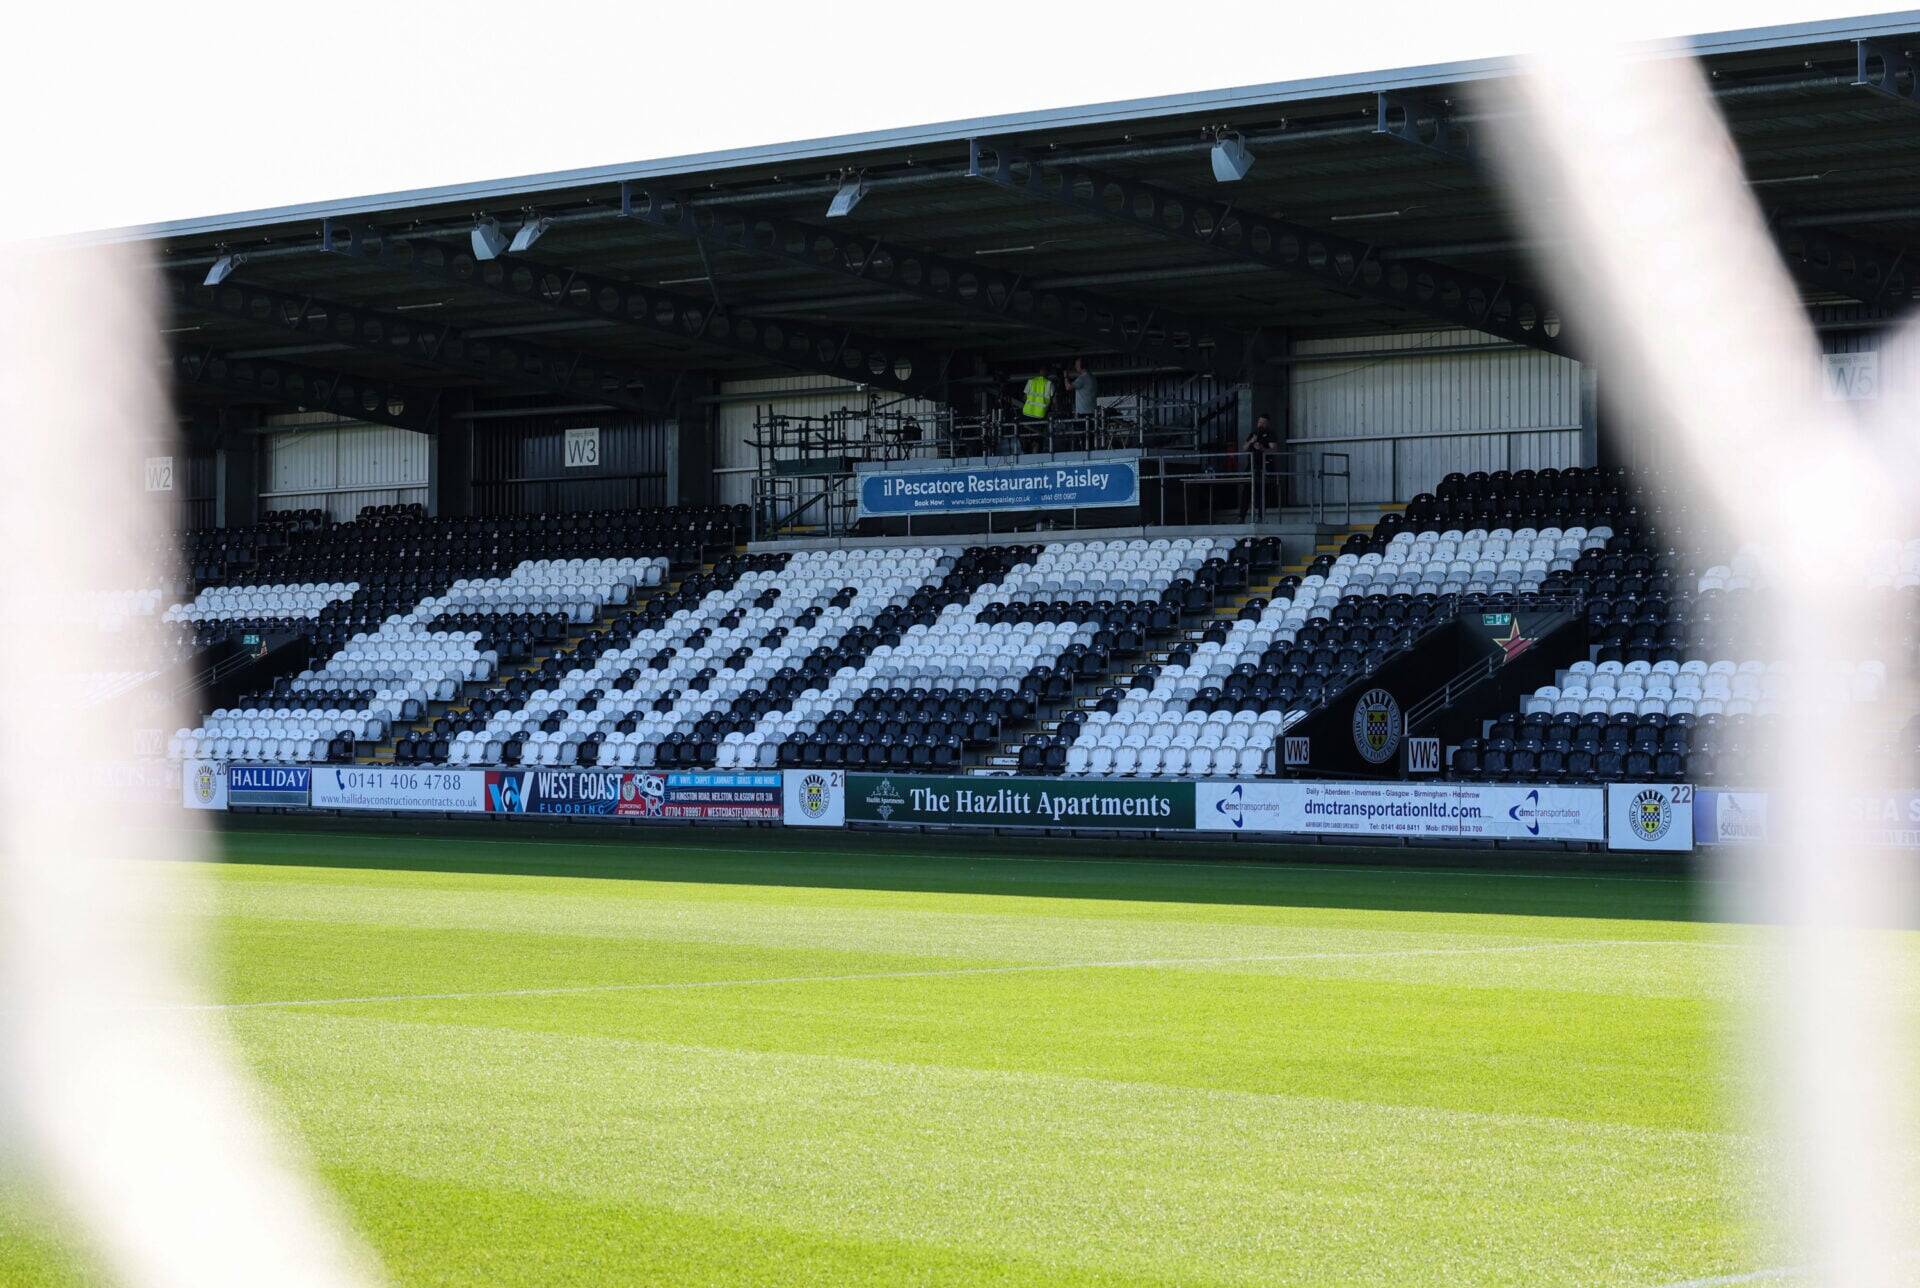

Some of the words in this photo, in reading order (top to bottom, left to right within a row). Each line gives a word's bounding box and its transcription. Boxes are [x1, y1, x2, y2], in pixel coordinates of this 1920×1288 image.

[1827, 367, 1873, 396] W5
[568, 439, 596, 464] W3
[148, 466, 171, 488] W2
[896, 479, 964, 496] Pescatore
[968, 474, 1052, 493] Restaurant,
[1056, 469, 1109, 491] Paisley
[914, 499, 929, 507] Book
[1287, 740, 1308, 762] VW3
[1411, 741, 1439, 769] VW3
[217, 762, 227, 776] 20
[232, 769, 307, 787] HALLIDAY
[349, 772, 382, 789] 0141
[390, 774, 418, 790] 406
[424, 775, 461, 791] 4788
[539, 773, 576, 799] WEST
[580, 774, 623, 800] COAST
[695, 776, 711, 785] CARPET
[831, 772, 844, 788] 21
[321, 793, 478, 808] www.hallidayconstructioncontracts.co.uk
[735, 793, 755, 802] GLASGOW
[1307, 789, 1320, 798] Daily
[1324, 789, 1350, 797] Aberdeen
[1354, 790, 1381, 798] Inverness
[1386, 791, 1409, 800] Glasgow
[1414, 791, 1447, 800] Birmingham
[1452, 791, 1480, 799] Heathrow
[1671, 786, 1692, 804] 22
[540, 803, 606, 815] FLOORING
[910, 788, 950, 813] The
[956, 789, 1031, 814] Hazlitt
[1037, 791, 1171, 821] Apartments
[1304, 800, 1481, 820] dmctransportationltd.com
